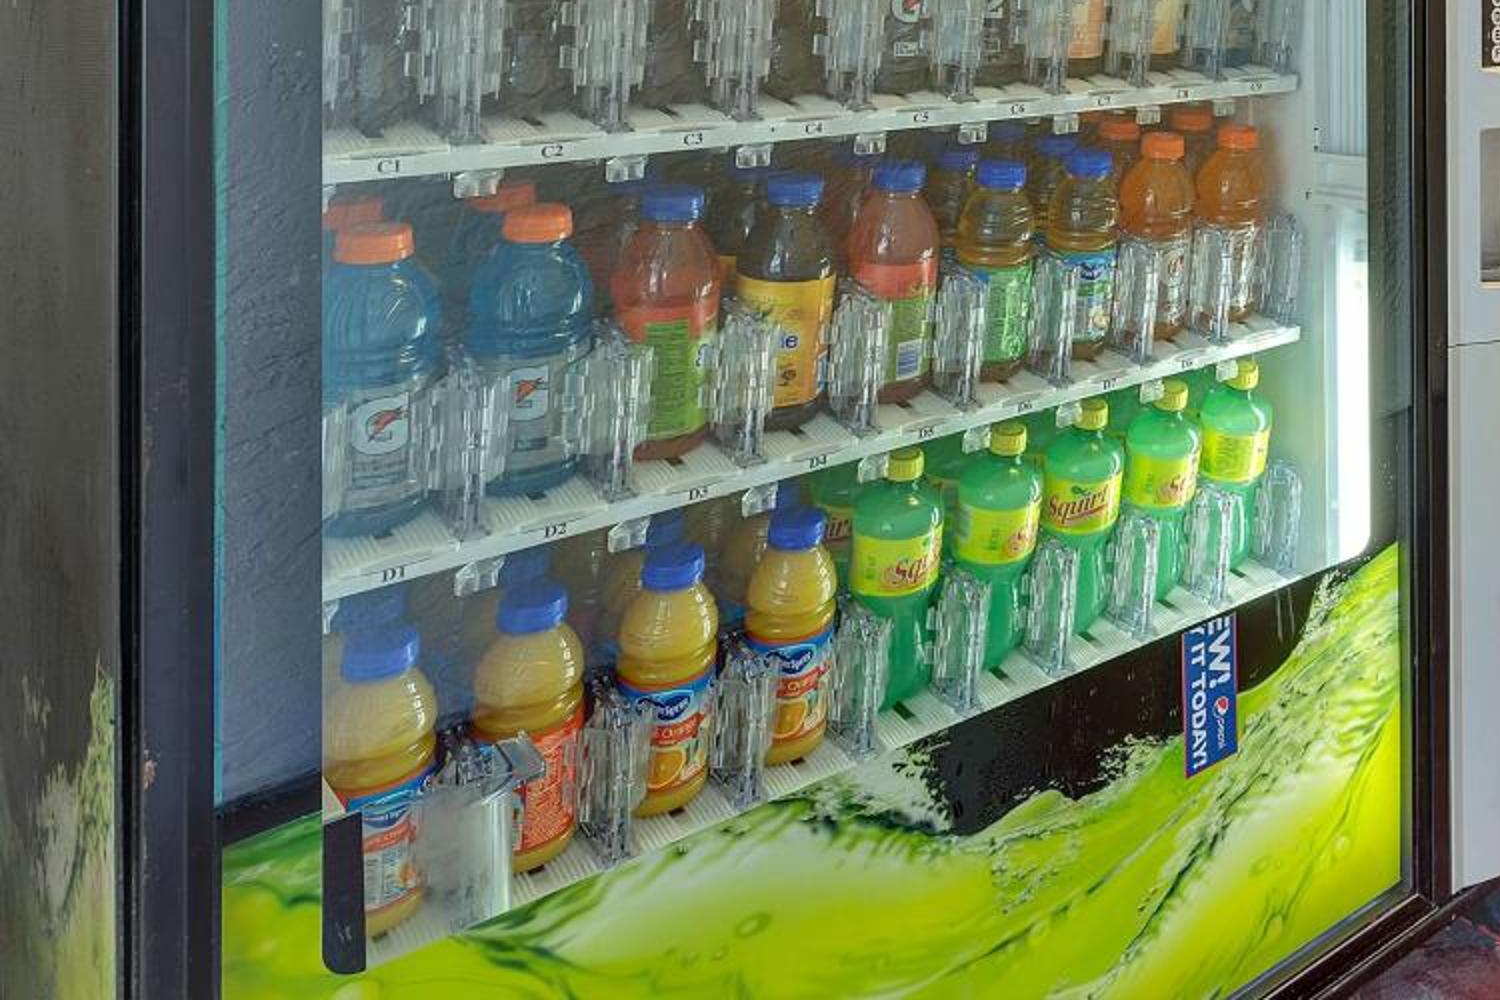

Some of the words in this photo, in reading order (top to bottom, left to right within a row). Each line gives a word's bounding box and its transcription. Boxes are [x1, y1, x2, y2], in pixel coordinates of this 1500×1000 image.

[913, 111, 929, 123] C5
[804, 122, 823, 135] C4
[683, 133, 703, 146] C3
[541, 145, 563, 159] C2
[377, 159, 400, 172] C1
[544, 522, 566, 538] D2
[382, 566, 405, 583] D1
[1190, 641, 1206, 667] IT
[1190, 671, 1208, 770] TODAY!
